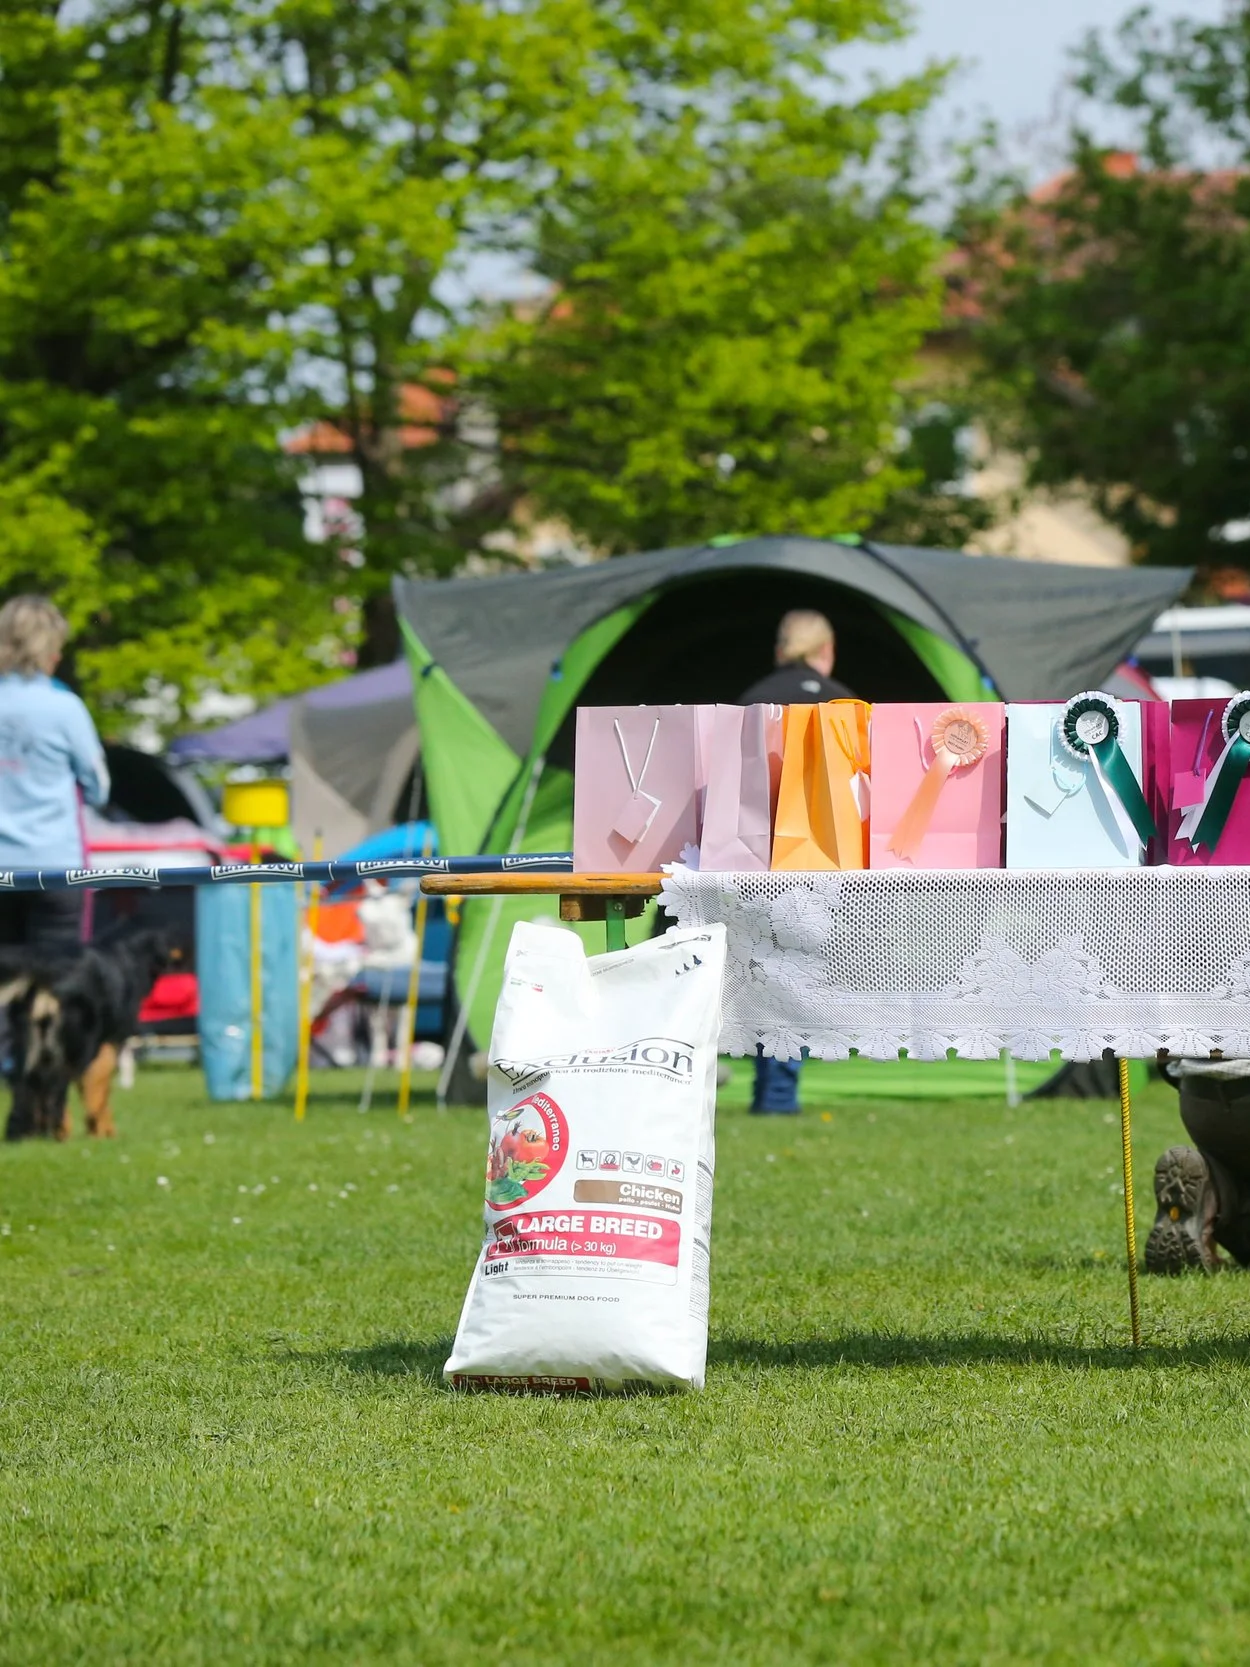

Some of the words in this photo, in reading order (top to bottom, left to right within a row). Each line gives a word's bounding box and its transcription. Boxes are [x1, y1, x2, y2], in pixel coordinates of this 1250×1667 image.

[1092, 730, 1103, 739] CAC
[495, 1044, 693, 1081] Exclusion
[620, 1183, 680, 1205] Chicken
[517, 1215, 585, 1233] LARGE
[590, 1216, 663, 1239] BREED
[517, 1236, 568, 1252] formula
[584, 1241, 597, 1251] 30
[600, 1241, 617, 1255] kg)
[485, 1262, 509, 1276] Light
[485, 1376, 529, 1385] LARGE
[533, 1376, 577, 1386] BREED
